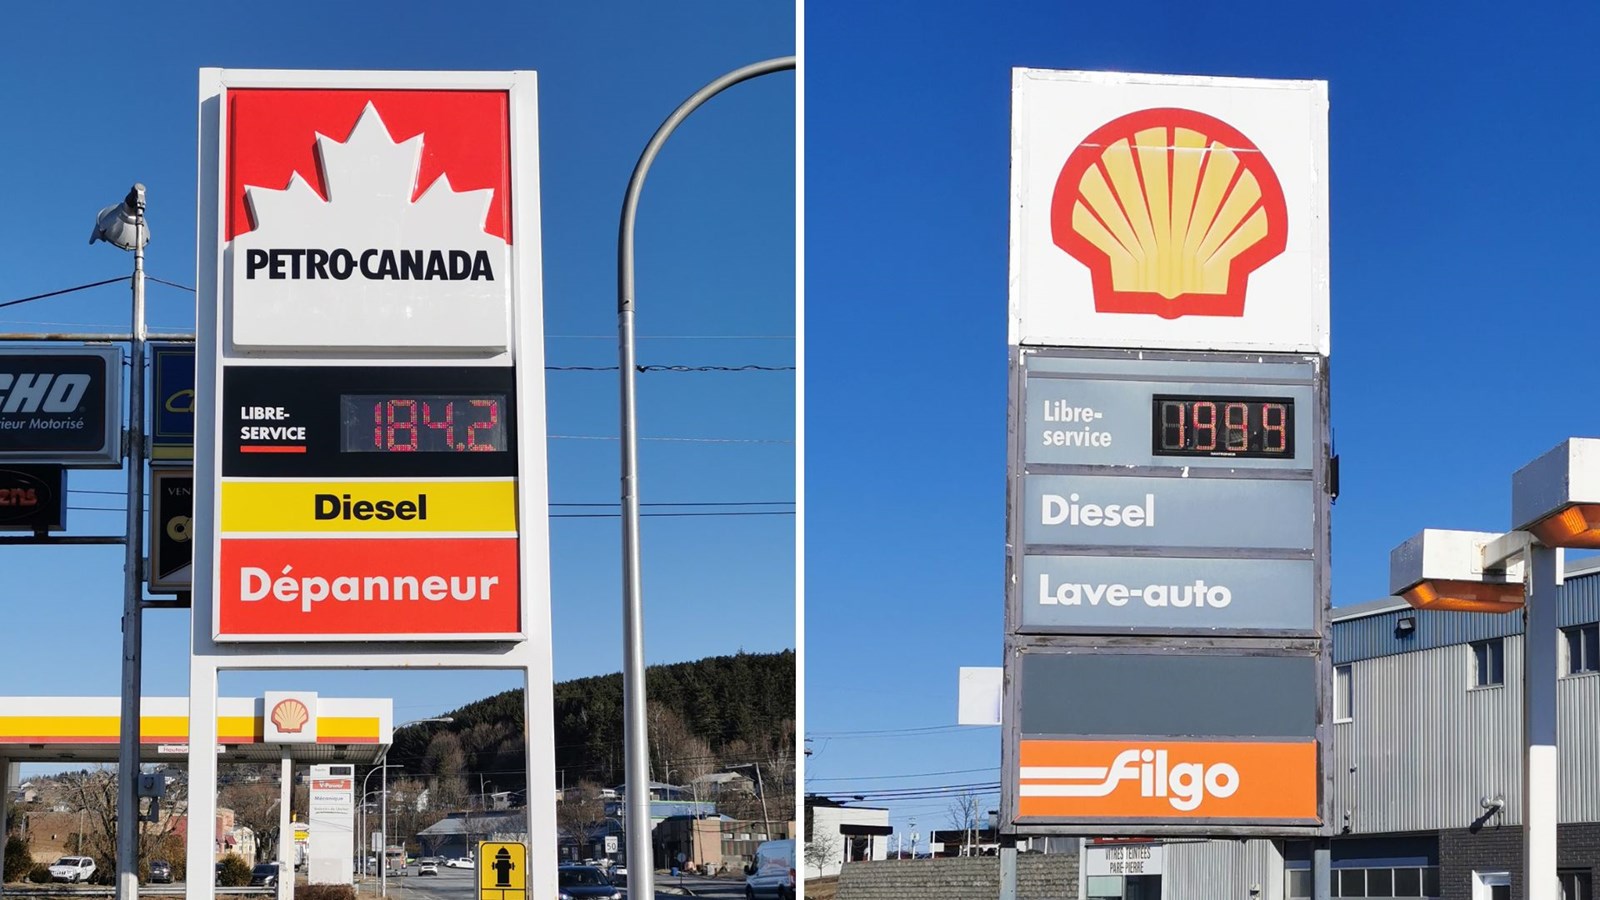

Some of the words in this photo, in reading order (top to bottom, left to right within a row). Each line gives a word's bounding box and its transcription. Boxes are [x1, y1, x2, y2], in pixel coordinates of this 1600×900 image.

[28, 416, 84, 430] Motorisé
[241, 406, 290, 420] LIBRE-
[1044, 400, 1102, 422] Libre-
[240, 426, 306, 440] SERVICE
[374, 400, 497, 451] 184.2
[1043, 426, 1112, 447] service
[314, 494, 427, 520] Diesel
[1041, 493, 1155, 527] Diesel
[240, 564, 499, 612] Dépanneur
[1039, 574, 1232, 608] Lave-auto
[1099, 748, 1240, 812] filgo
[607, 842, 616, 851] 50
